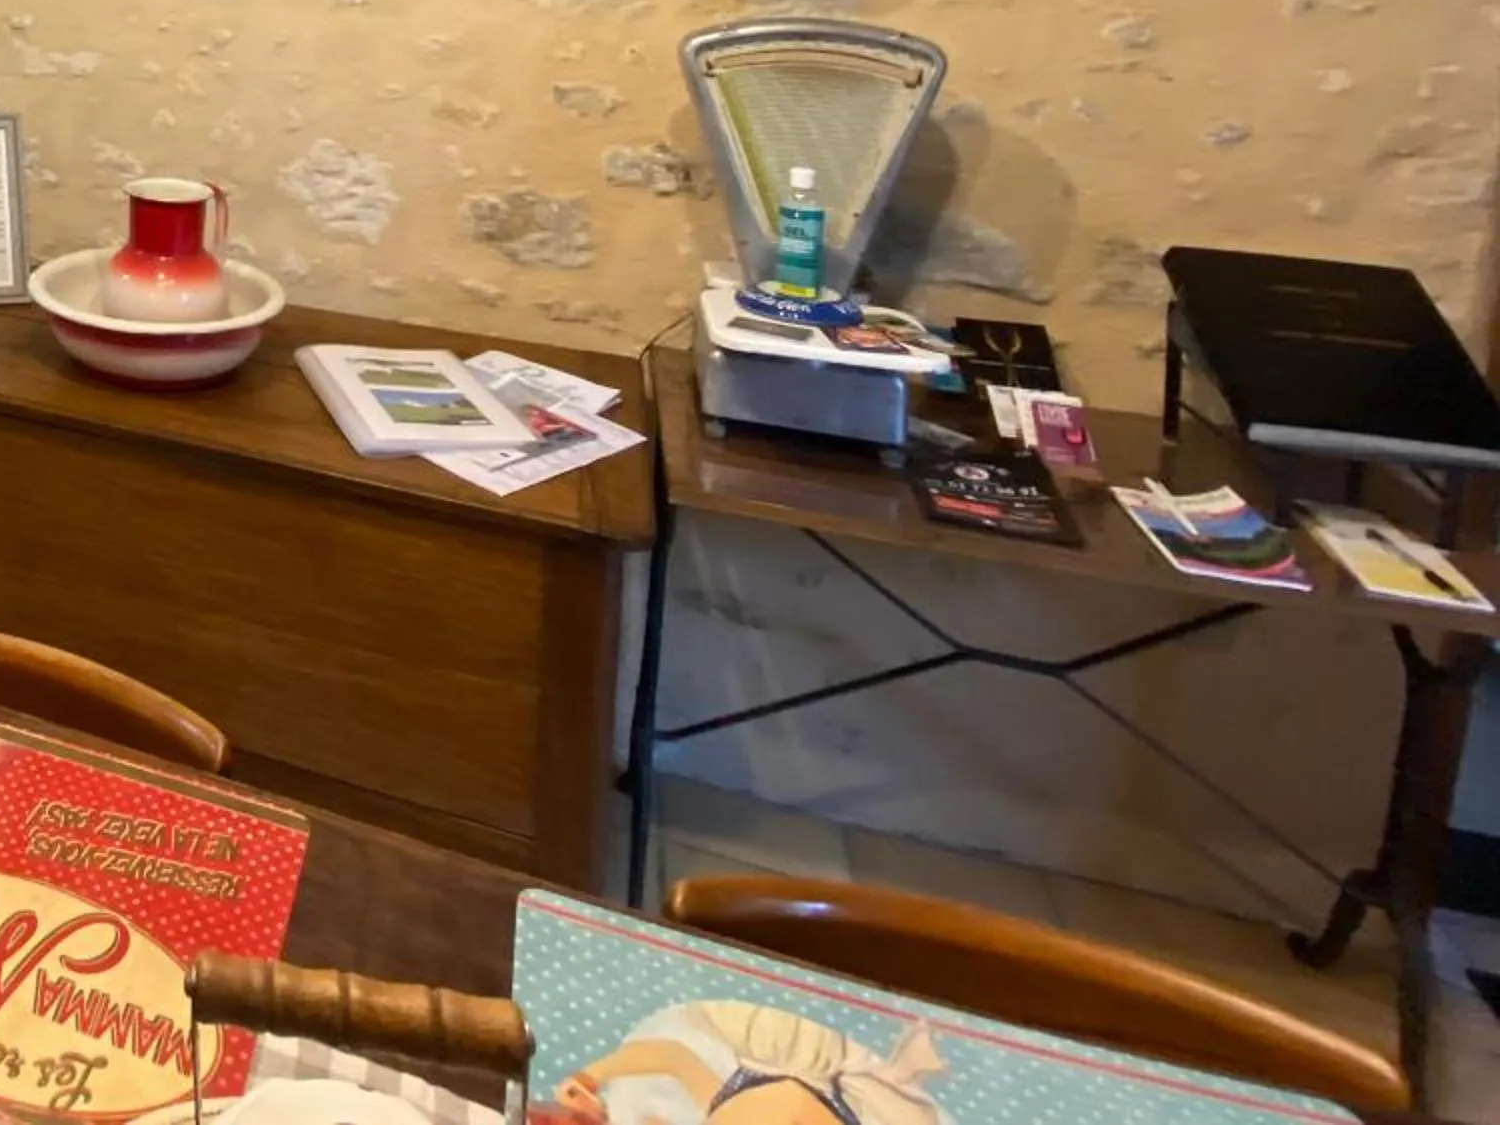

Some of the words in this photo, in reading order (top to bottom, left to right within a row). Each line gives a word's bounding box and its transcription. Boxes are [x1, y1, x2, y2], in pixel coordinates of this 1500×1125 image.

[96, 811, 166, 849] VEXEZ
[171, 825, 204, 859] LA
[202, 831, 240, 863] NE
[33, 967, 193, 1078] MAMMA
[32, 1051, 108, 1111] Les
